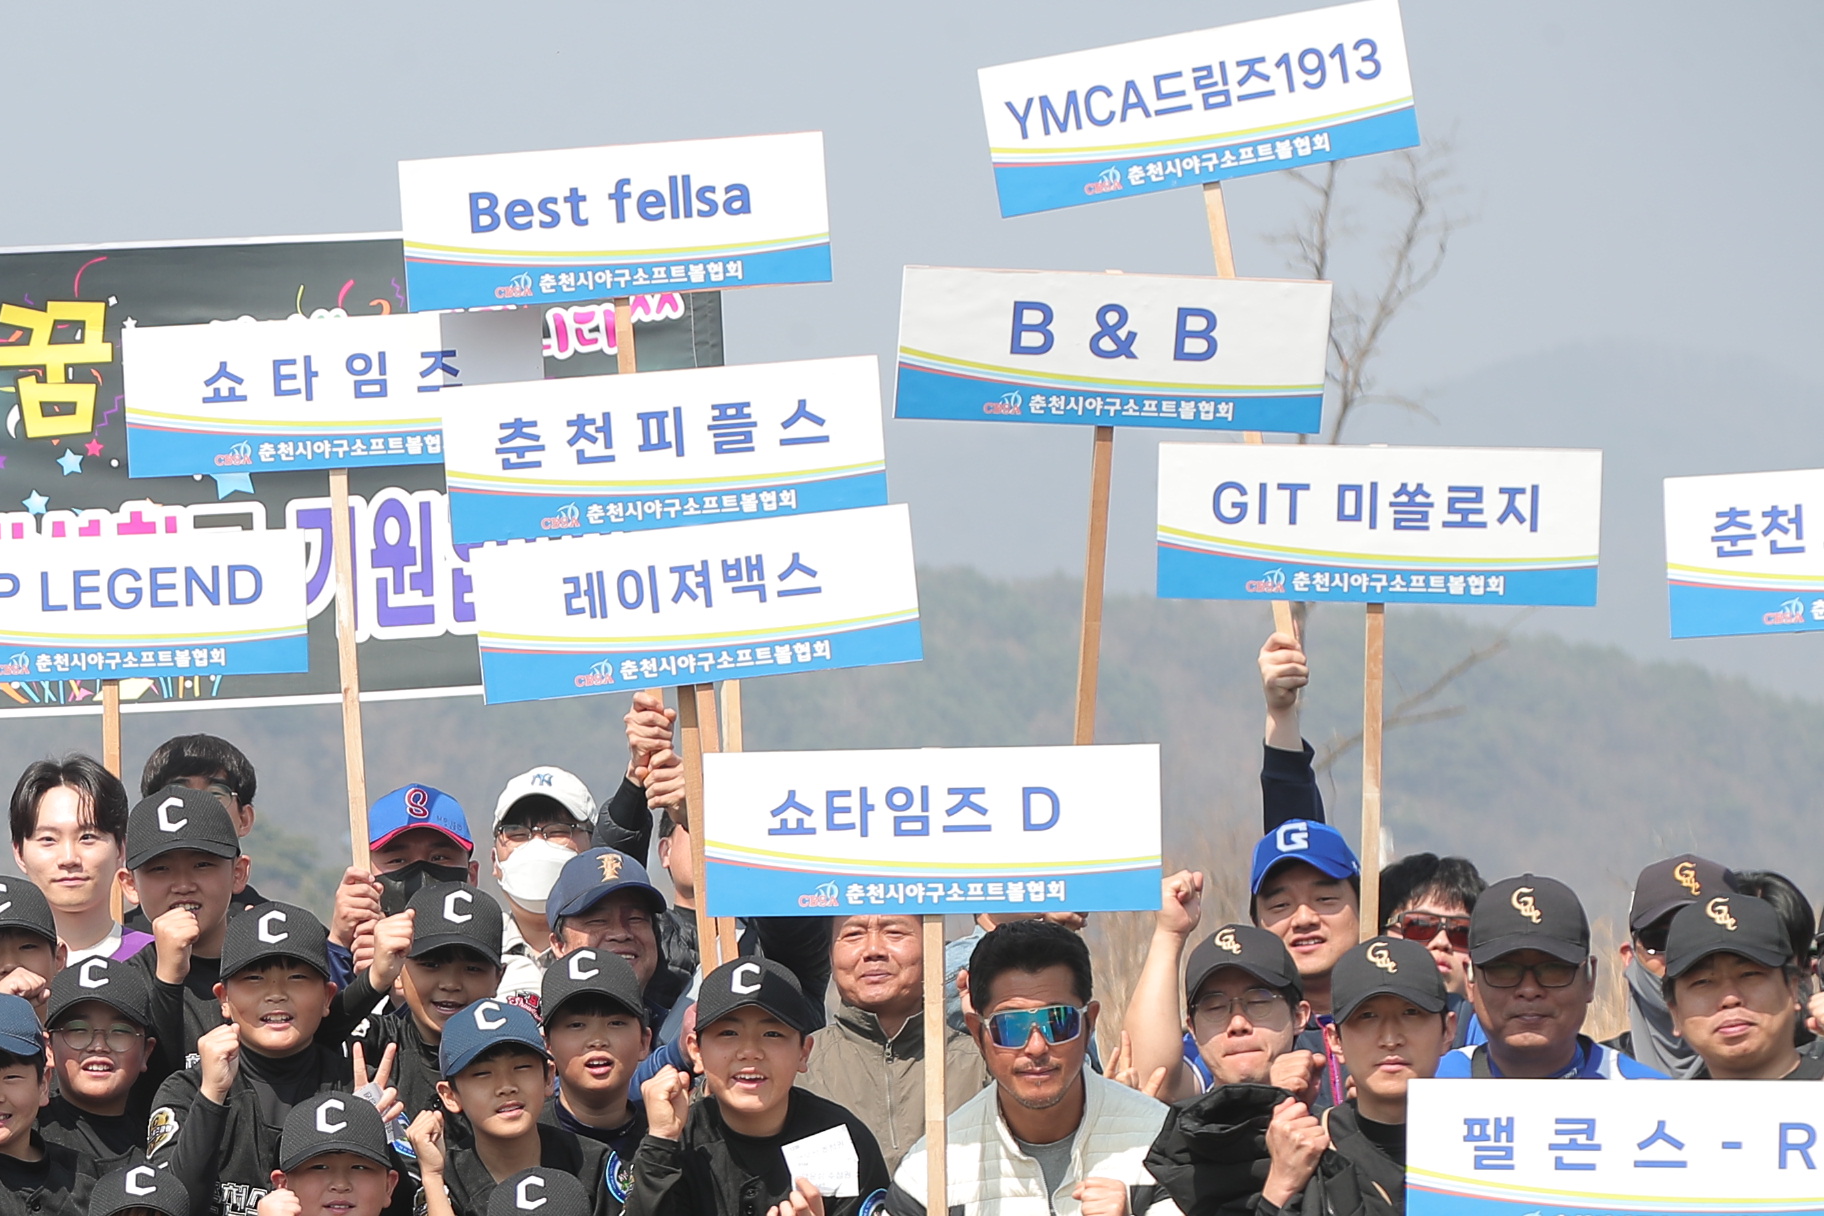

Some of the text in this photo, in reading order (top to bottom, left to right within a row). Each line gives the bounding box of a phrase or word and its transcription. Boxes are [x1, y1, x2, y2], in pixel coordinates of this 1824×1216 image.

[1004, 37, 1382, 140] YMCA드림즈1913
[1127, 131, 1331, 186] 춘천시야구소프트볼협회
[468, 174, 752, 234] Best fellsa
[539, 260, 743, 293] 춘천시야구소프트볼협회
[1010, 300, 1218, 362] B & B
[1028, 395, 1234, 421] 춘천시야구소프트볼협회
[257, 432, 445, 461] 춘천시야구소프트볼협
[586, 489, 798, 525] 춘천시야구소프트볼협회
[1212, 481, 1542, 533] GIT 미쏠로지
[41, 564, 263, 613] LEGEND
[563, 552, 822, 620] 레이져백스
[1292, 571, 1505, 597] 춘천시야구소프트볼협회
[35, 647, 226, 673] 춘천시야구소프트볼협회
[619, 639, 832, 681] 춘천시야구소프트볼협회
[767, 784, 1061, 838] 쇼타임즈 D
[845, 881, 1066, 905] 춘천시야구소프트볼협회
